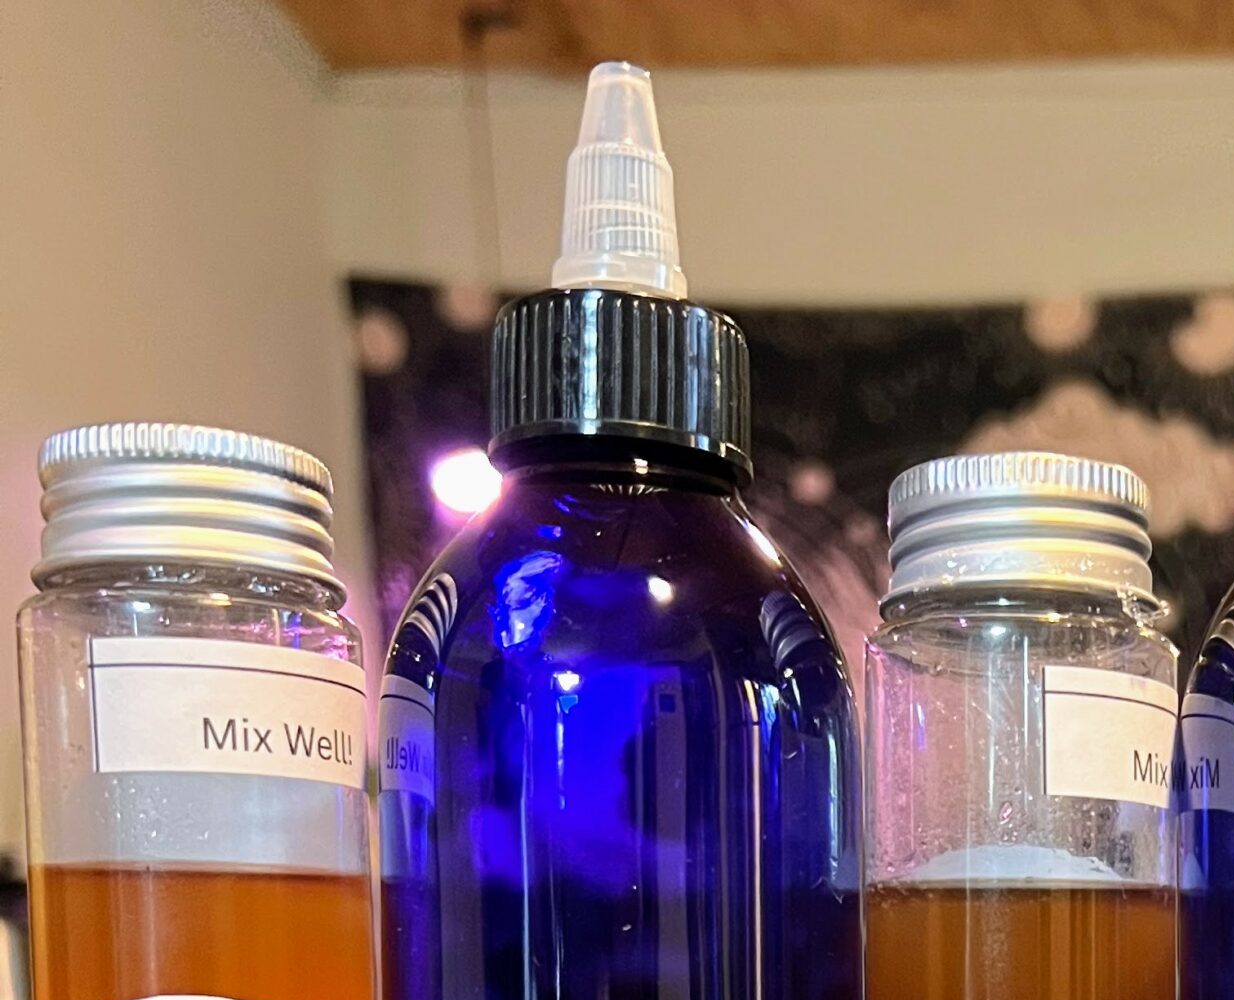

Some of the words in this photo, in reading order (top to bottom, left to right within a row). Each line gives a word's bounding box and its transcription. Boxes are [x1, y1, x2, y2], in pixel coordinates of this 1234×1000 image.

[202, 717, 272, 754] Mix
[283, 722, 353, 766] Well!
[1133, 750, 1168, 788] Mix
